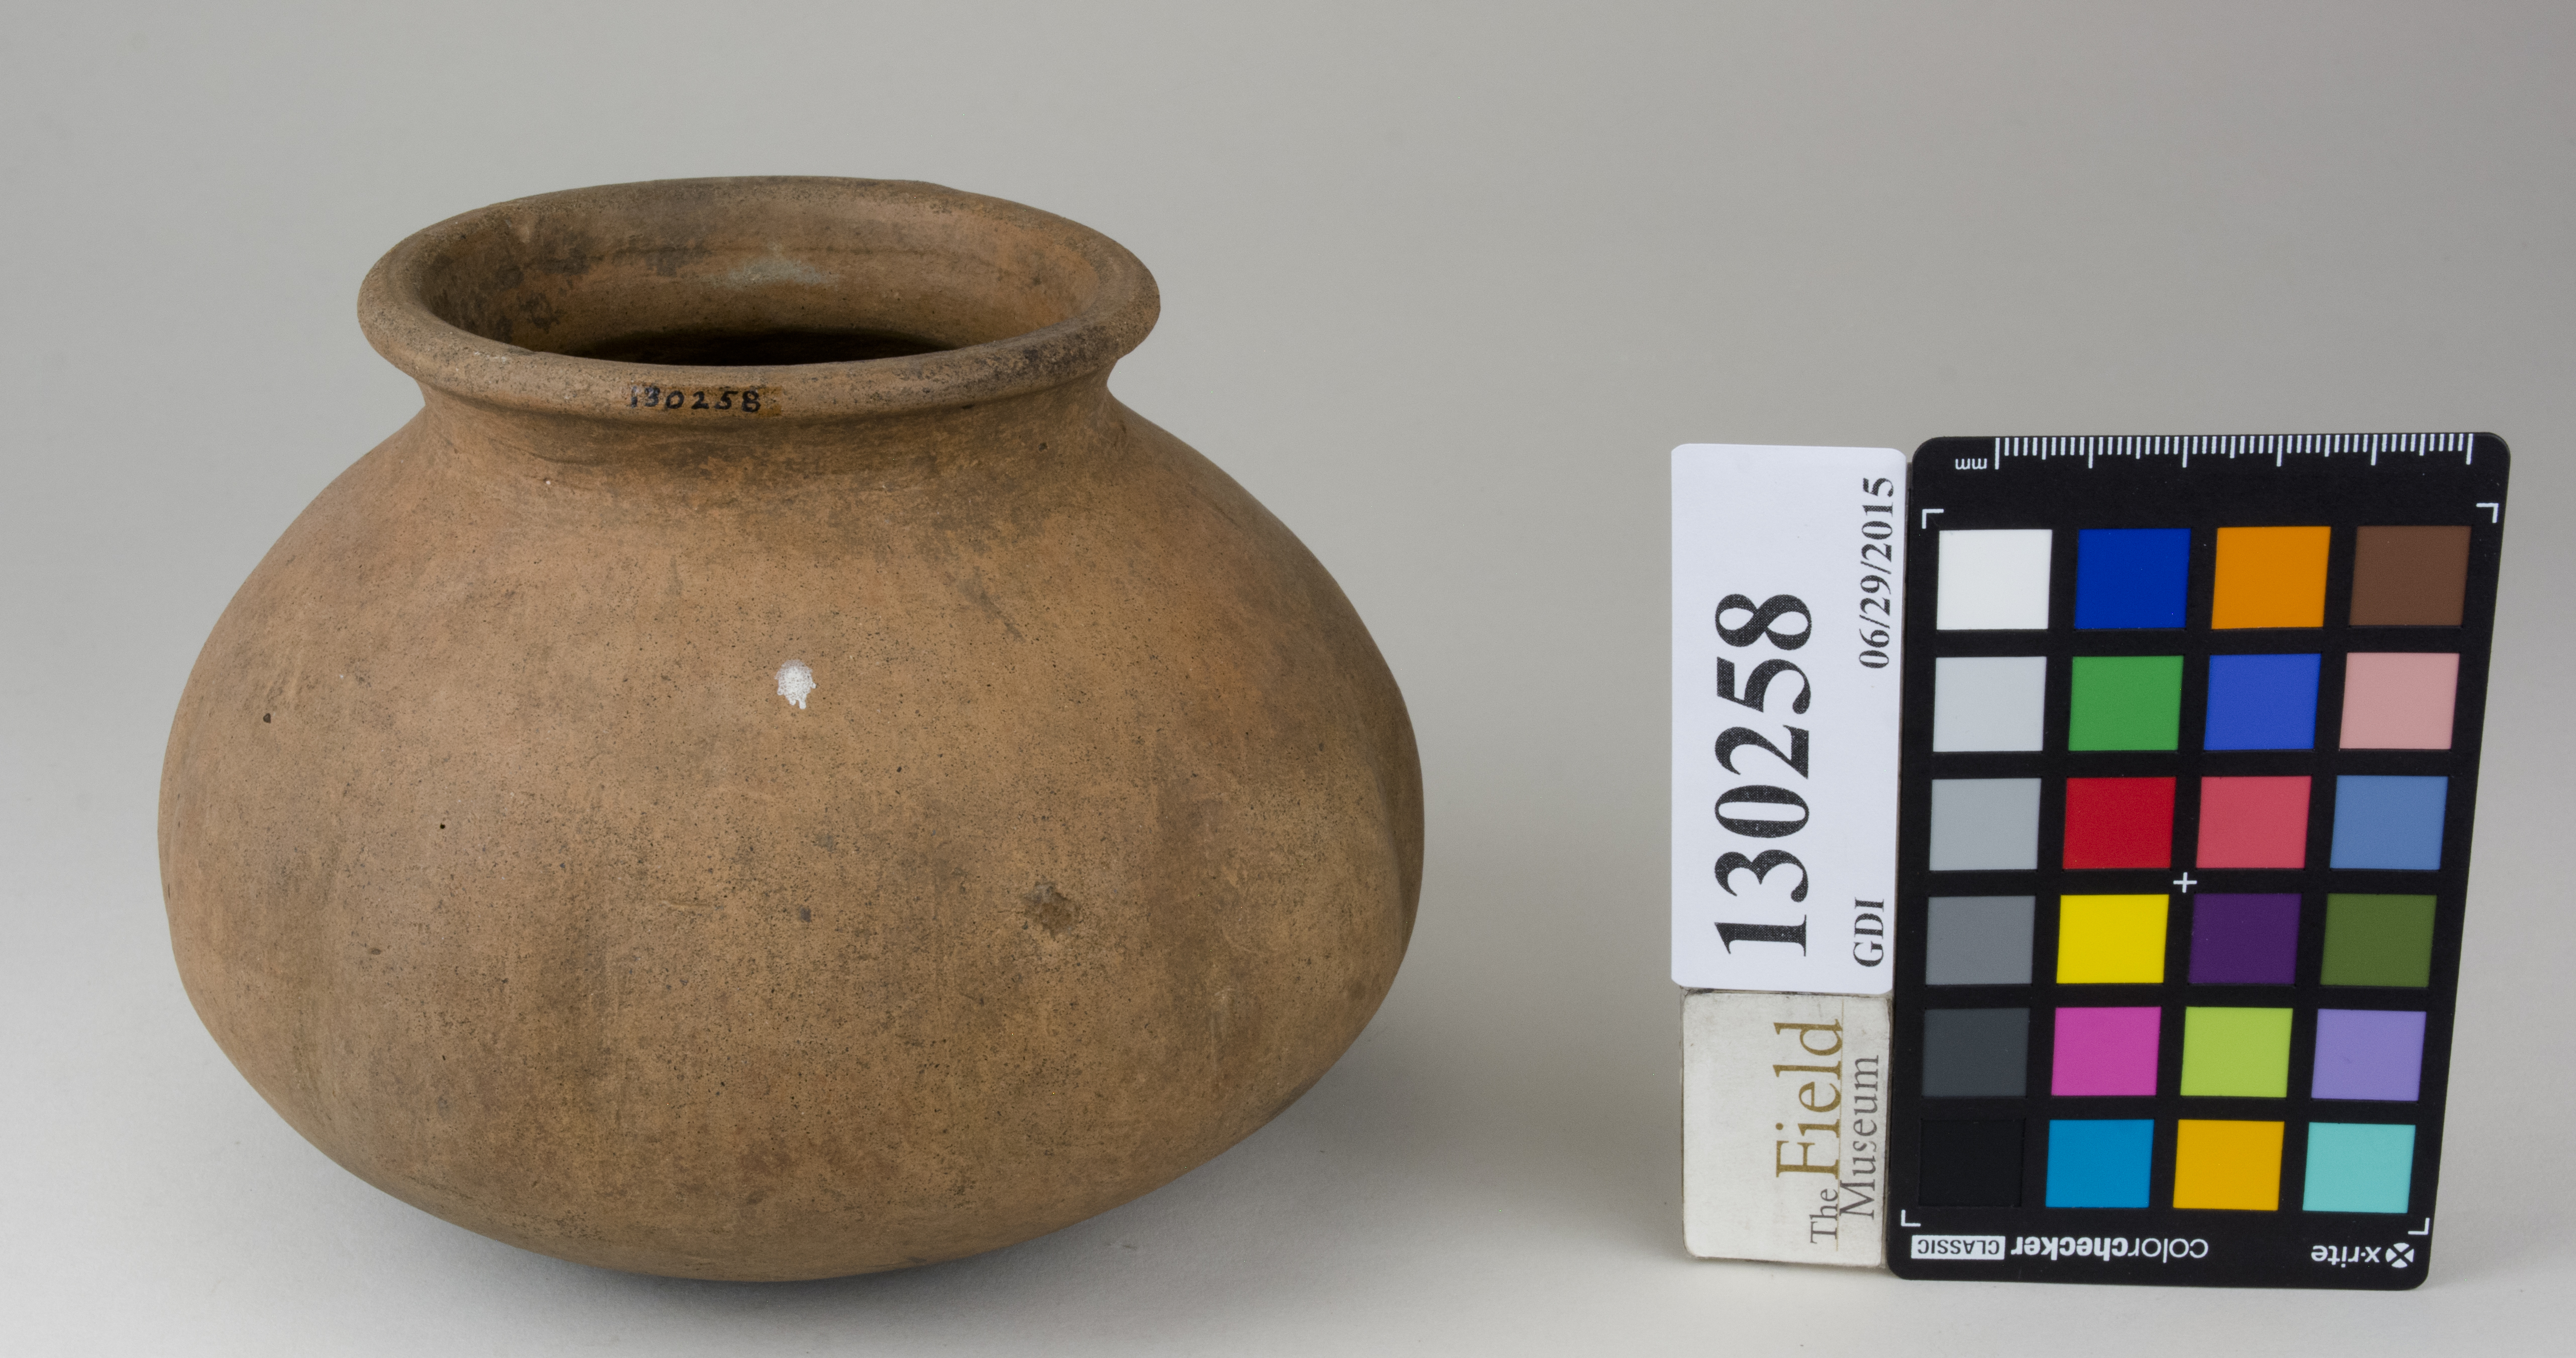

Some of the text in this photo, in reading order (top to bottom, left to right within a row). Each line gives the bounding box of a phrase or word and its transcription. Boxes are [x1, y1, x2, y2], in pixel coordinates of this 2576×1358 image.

[630, 386, 761, 413] 130258
[1955, 458, 1987, 470] mm
[1859, 478, 1894, 668] 06/29/2015
[1714, 594, 1812, 956] 130258
[1853, 897, 1884, 967] GDI
[1773, 1019, 1843, 1243] The Field
[1840, 1055, 1879, 1220] Museum
[1917, 1239, 2000, 1255] CLASSIC
